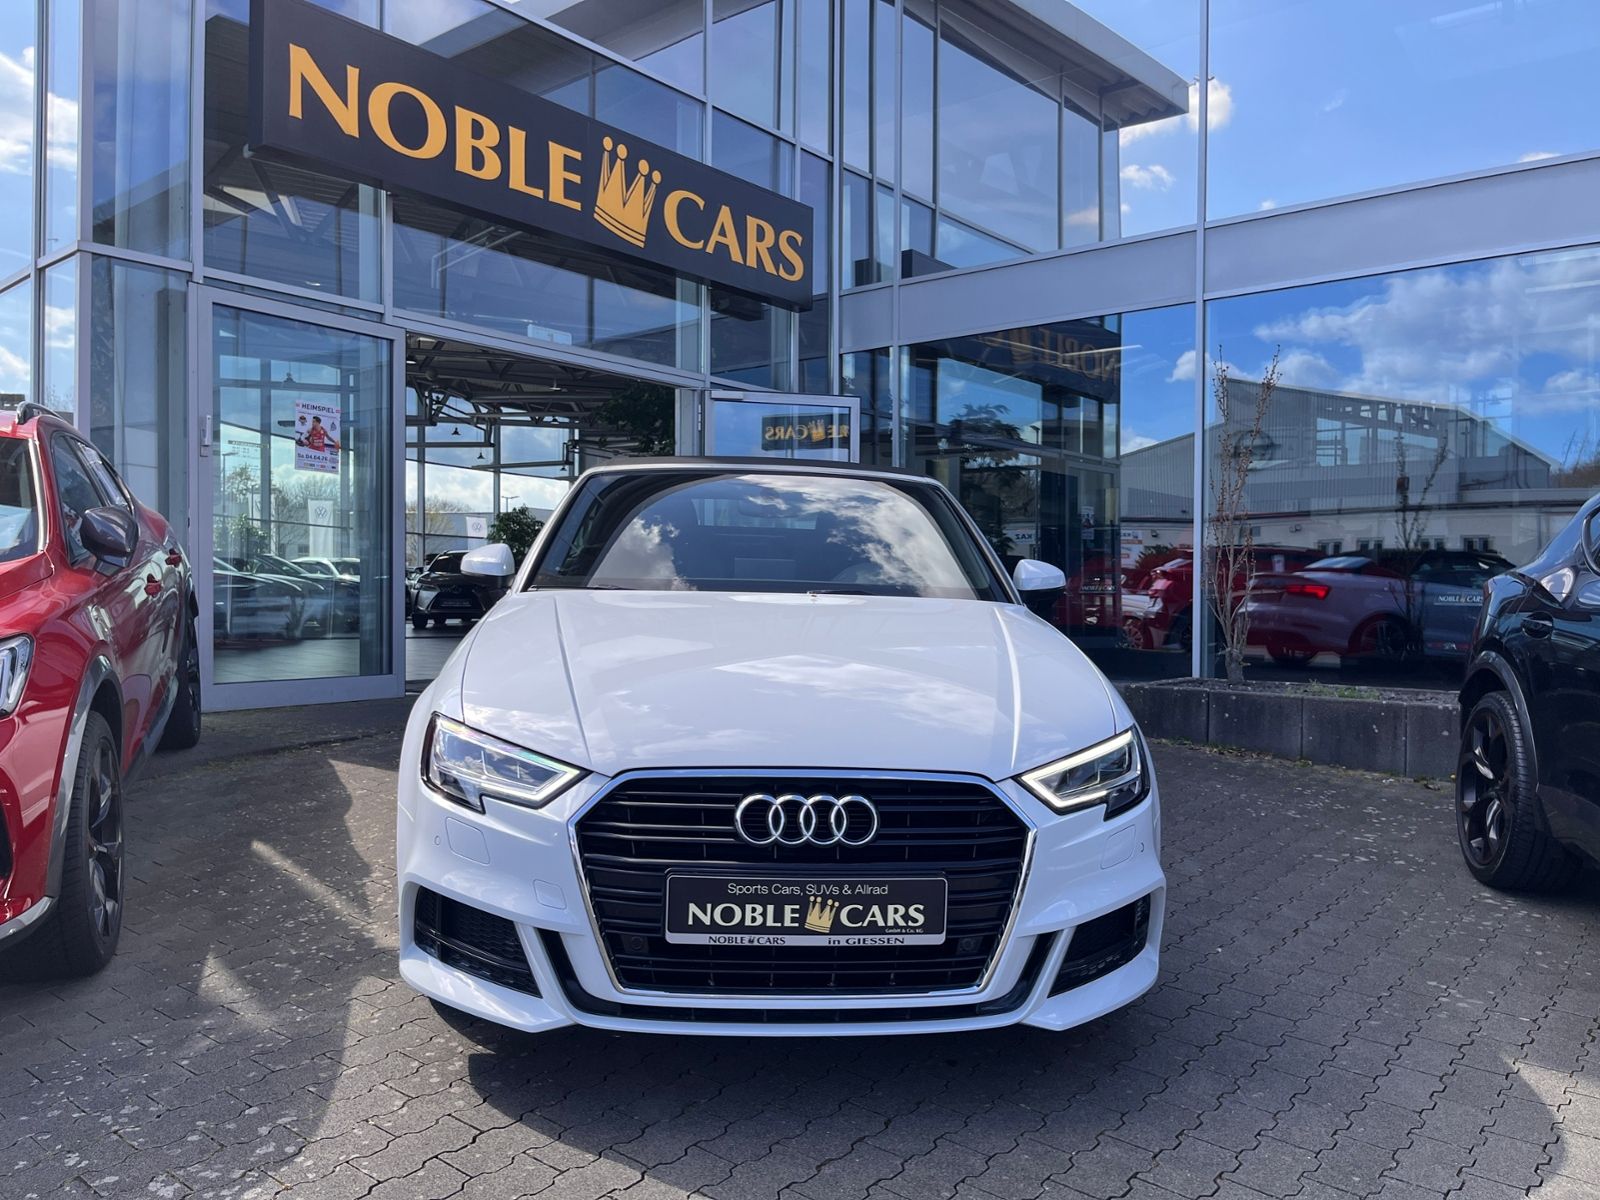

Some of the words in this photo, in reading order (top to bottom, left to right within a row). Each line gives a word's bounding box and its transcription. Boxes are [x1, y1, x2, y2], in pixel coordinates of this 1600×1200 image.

[288, 42, 582, 211] NOBLE
[662, 189, 805, 282] CARS
[301, 403, 335, 414] HEIMSPIEL
[727, 883, 769, 896] Sports
[771, 883, 804, 896] Cars,
[806, 884, 839, 895] SUVs
[842, 884, 852, 895] &
[855, 884, 889, 895] Allrad
[687, 902, 800, 927] NOBLE
[840, 904, 925, 928] CARS
[708, 936, 746, 944] NOBLE
[757, 936, 786, 945] CARS
[828, 937, 841, 945] in
[845, 937, 905, 945] GIESSEN
